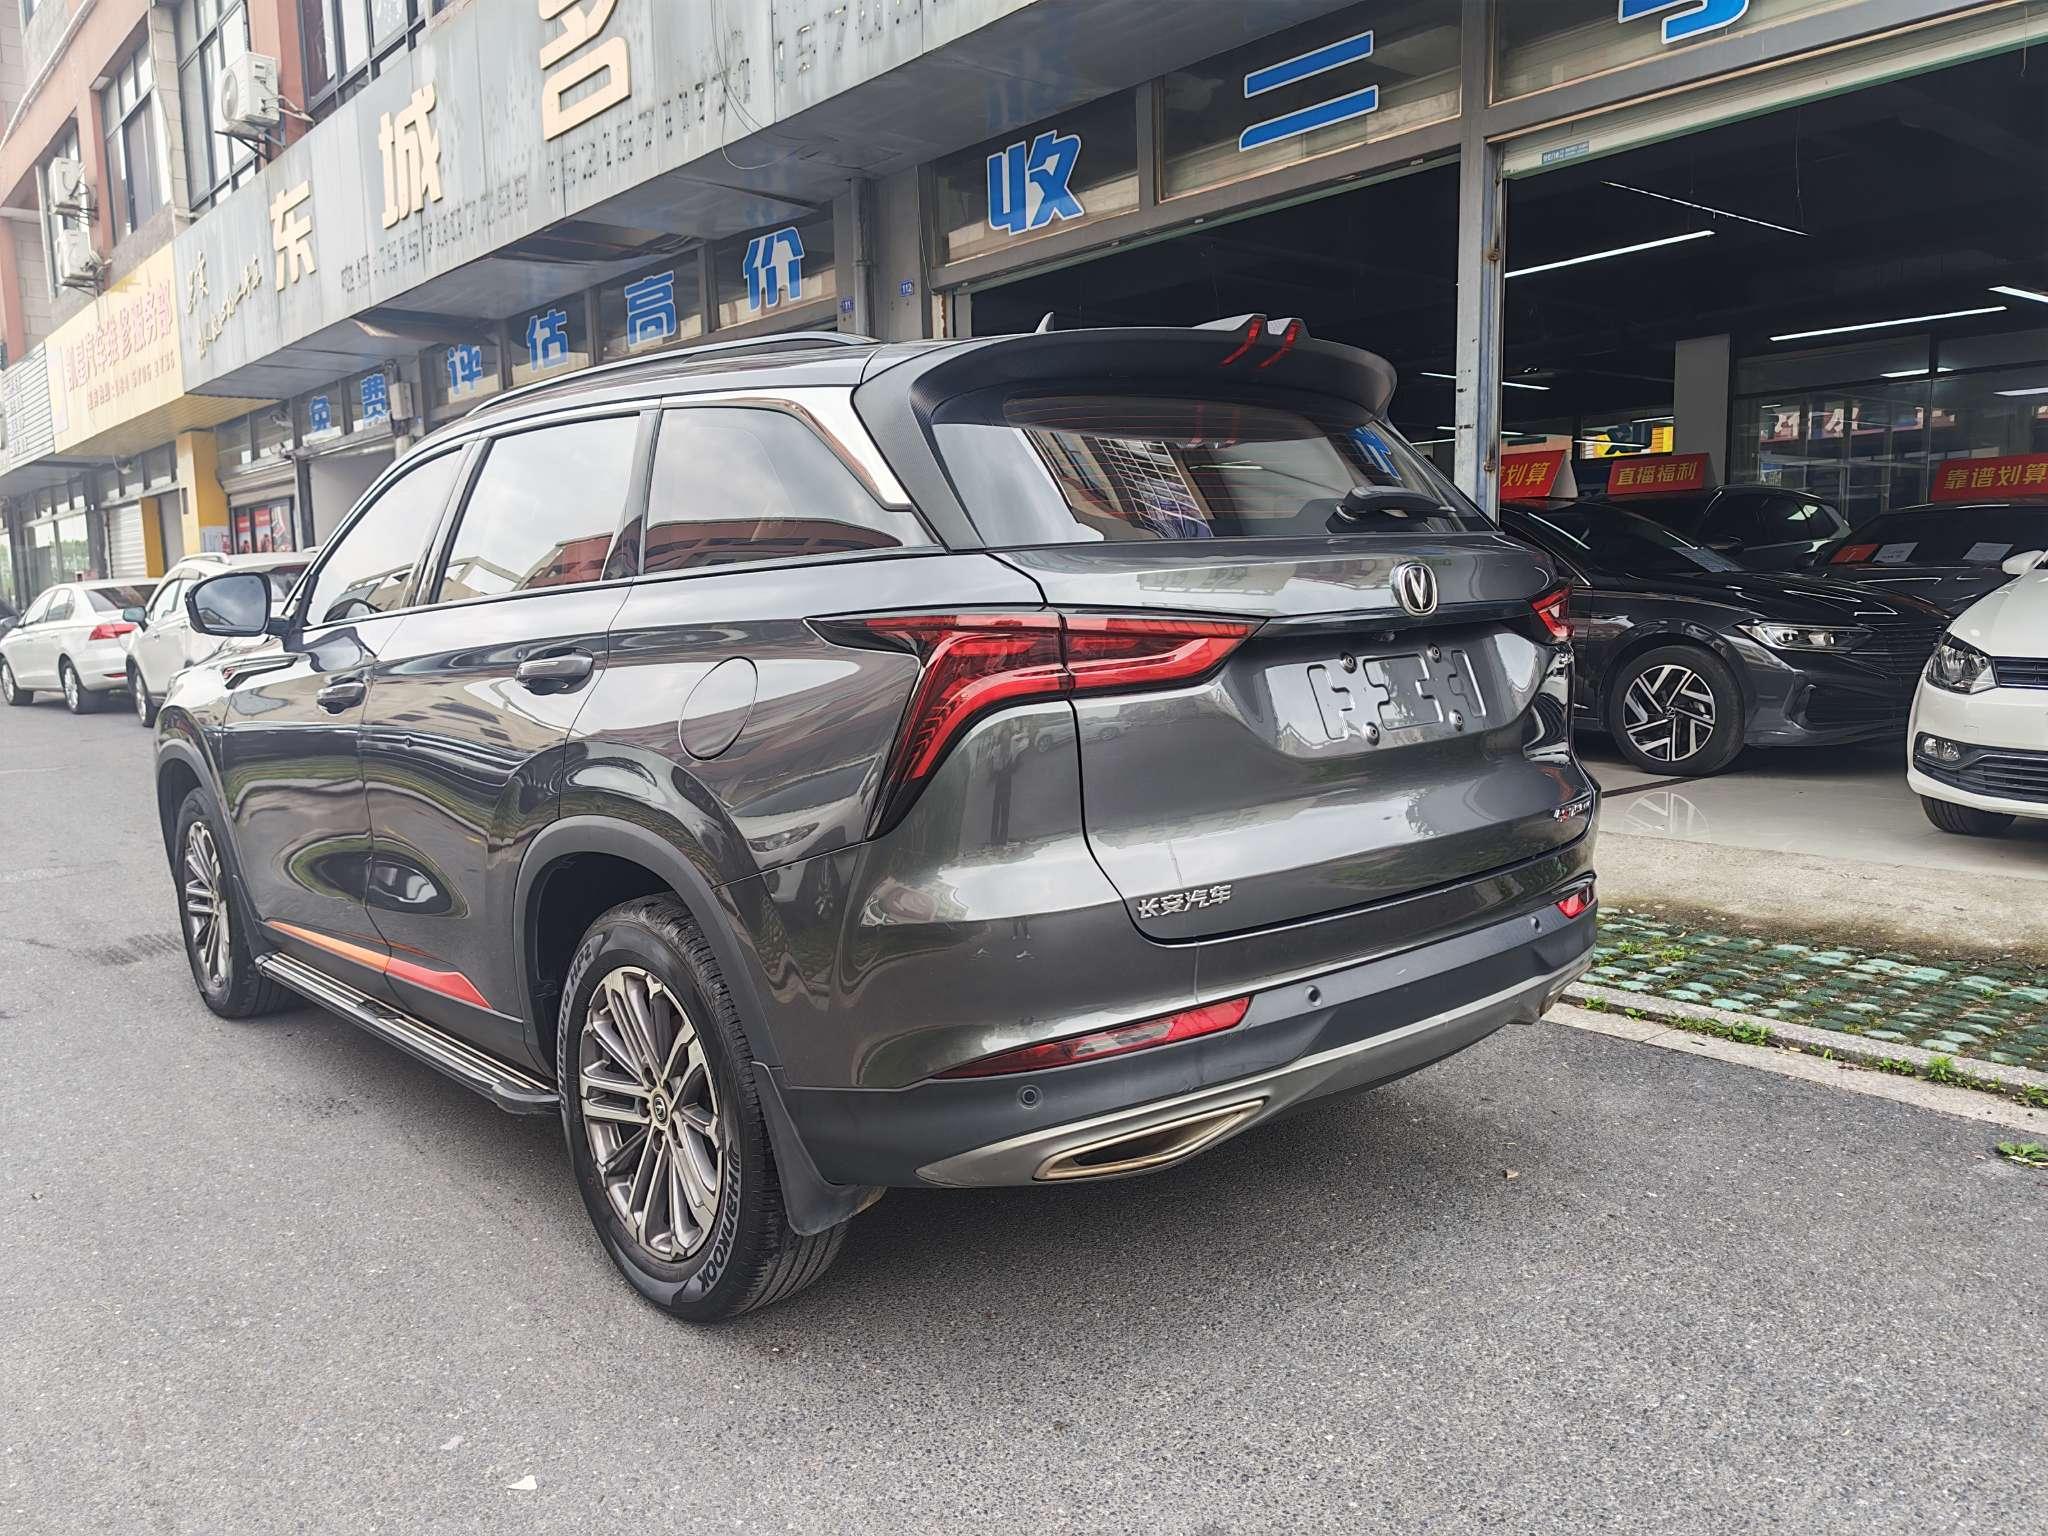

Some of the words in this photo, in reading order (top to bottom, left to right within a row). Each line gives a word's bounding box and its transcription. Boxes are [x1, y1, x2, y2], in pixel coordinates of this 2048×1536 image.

[1500, 460, 1551, 487] 划算
[1616, 461, 1698, 487] 直播福利
[1943, 462, 2048, 490] 靠谱划算
[1137, 884, 1232, 919] 长安汽车
